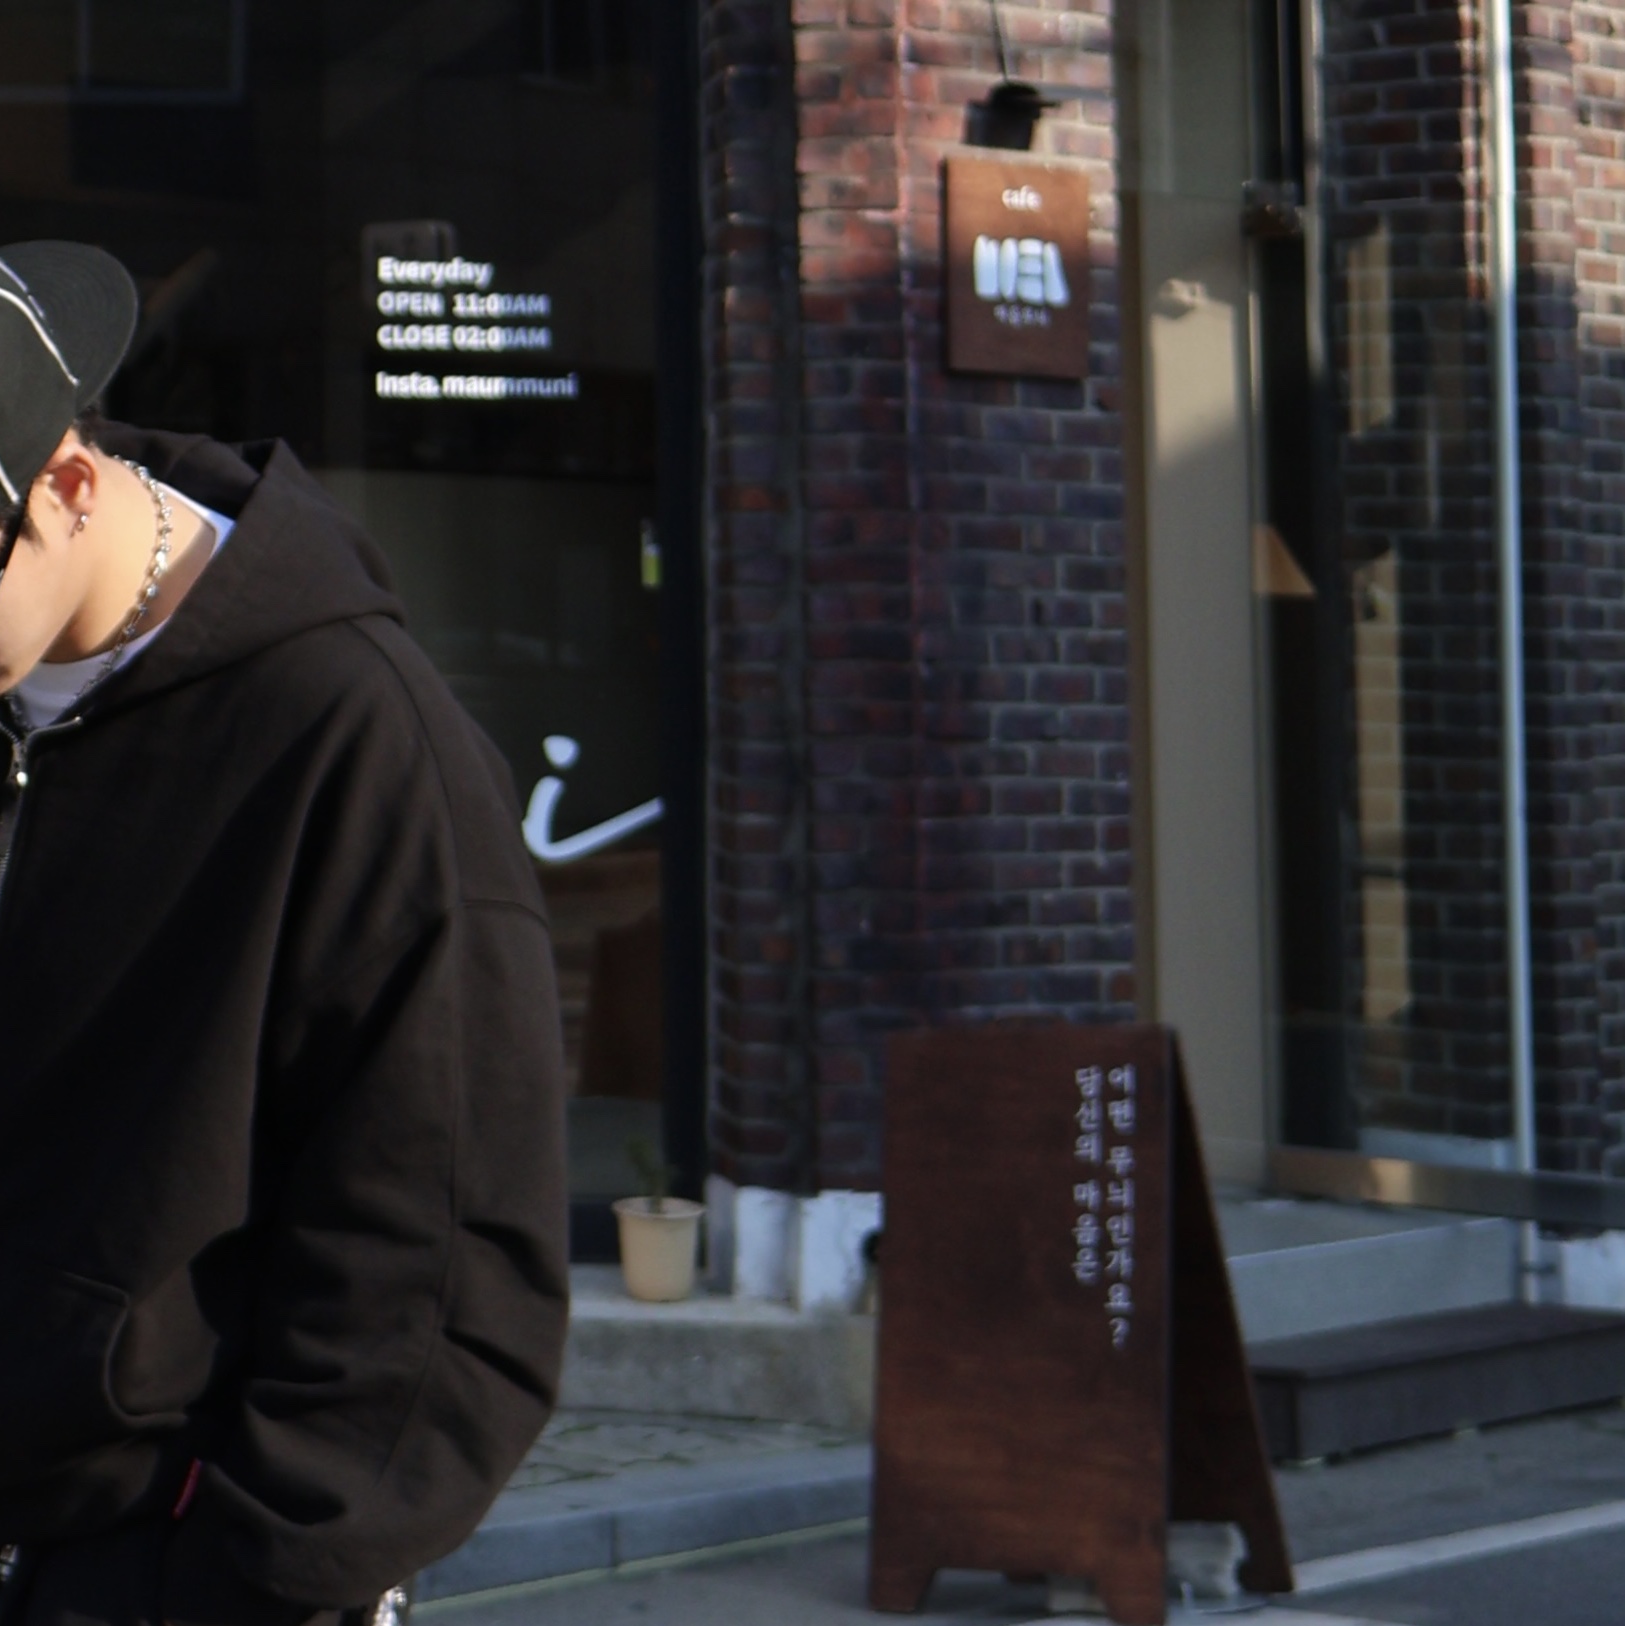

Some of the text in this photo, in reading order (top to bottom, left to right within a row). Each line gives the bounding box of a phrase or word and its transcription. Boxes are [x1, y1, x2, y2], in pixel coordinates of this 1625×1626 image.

[1002, 184, 1043, 211] cafe
[377, 256, 493, 289] Everyday
[377, 291, 550, 318] OPEN 11:00AM
[377, 324, 551, 351] CLOSE 02:00AM
[1072, 1064, 1103, 1284] 당신의 마음은
[1105, 1063, 1136, 1348] 어떤 무늬인가요?
